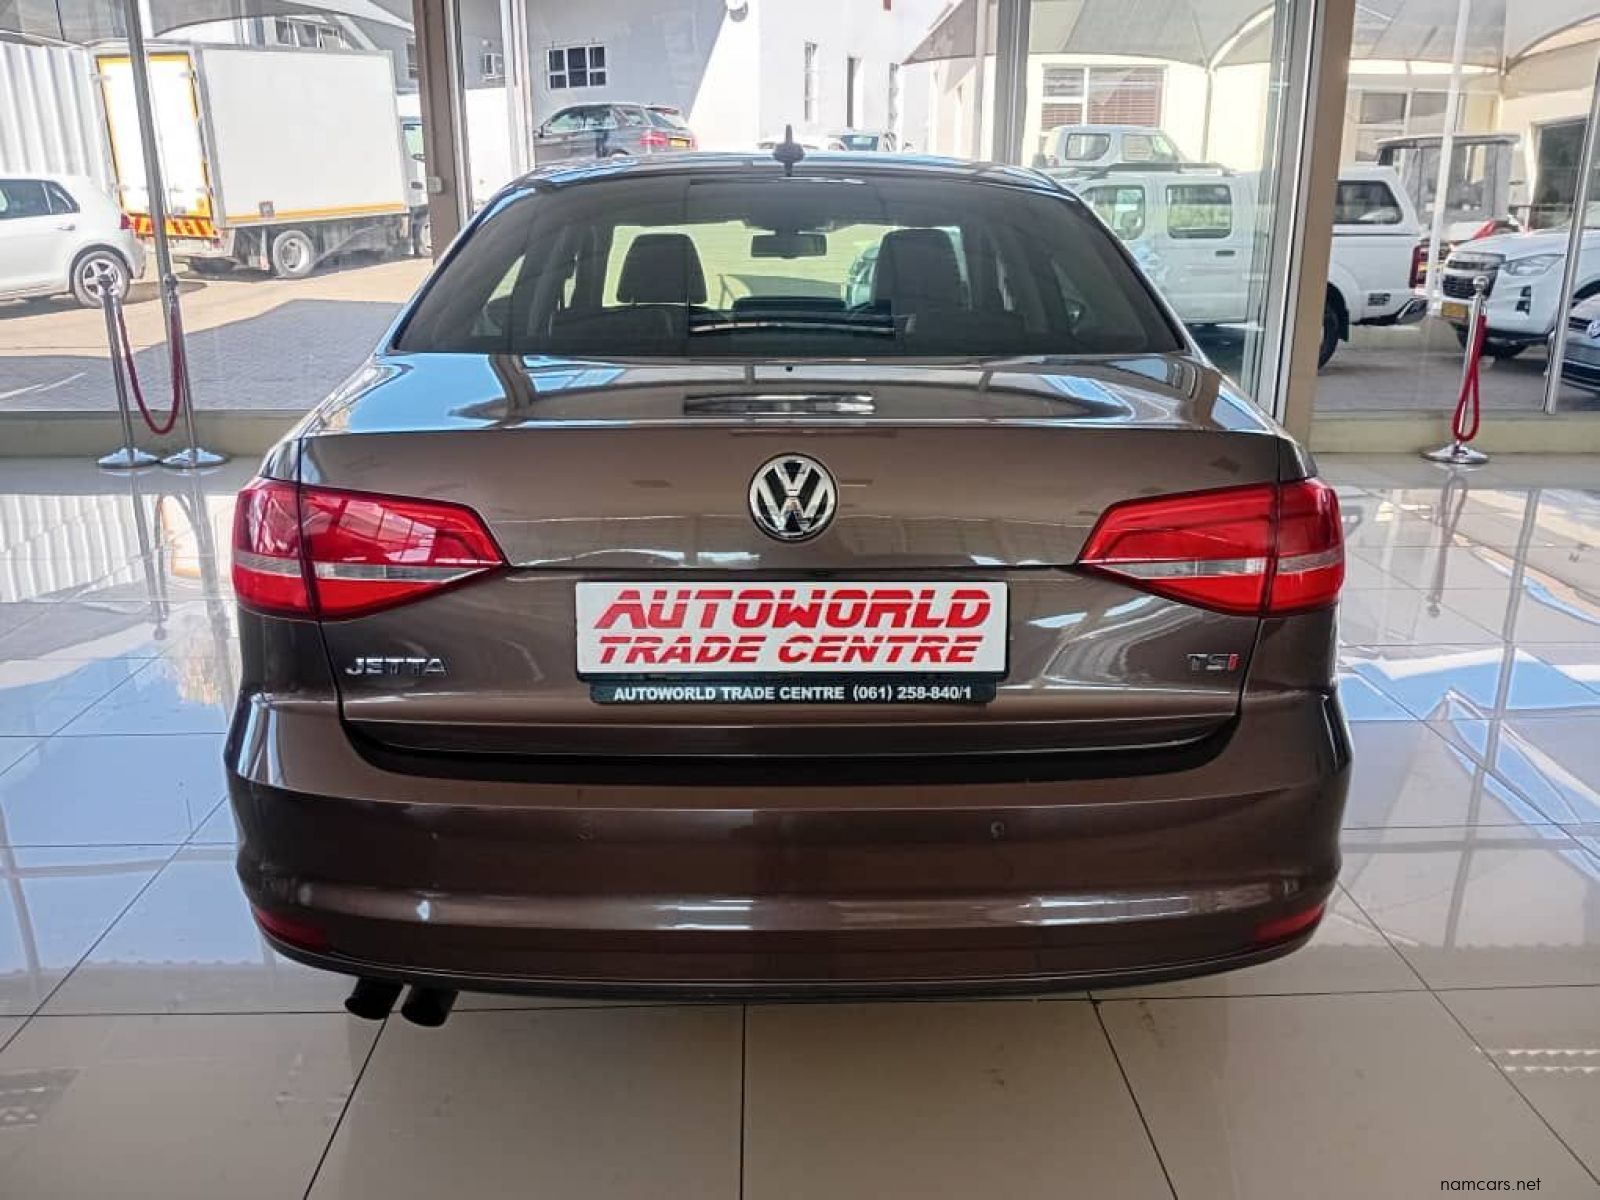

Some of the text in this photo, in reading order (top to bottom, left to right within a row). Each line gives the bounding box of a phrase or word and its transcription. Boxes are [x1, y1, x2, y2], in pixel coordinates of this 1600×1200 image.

[595, 589, 991, 629] AUTOWORLD
[600, 636, 984, 663] TRADE CENTRE
[345, 657, 447, 675] JETTA
[613, 686, 972, 703] AUTOWORLD TRADE CENTRE (061) 258-840/1
